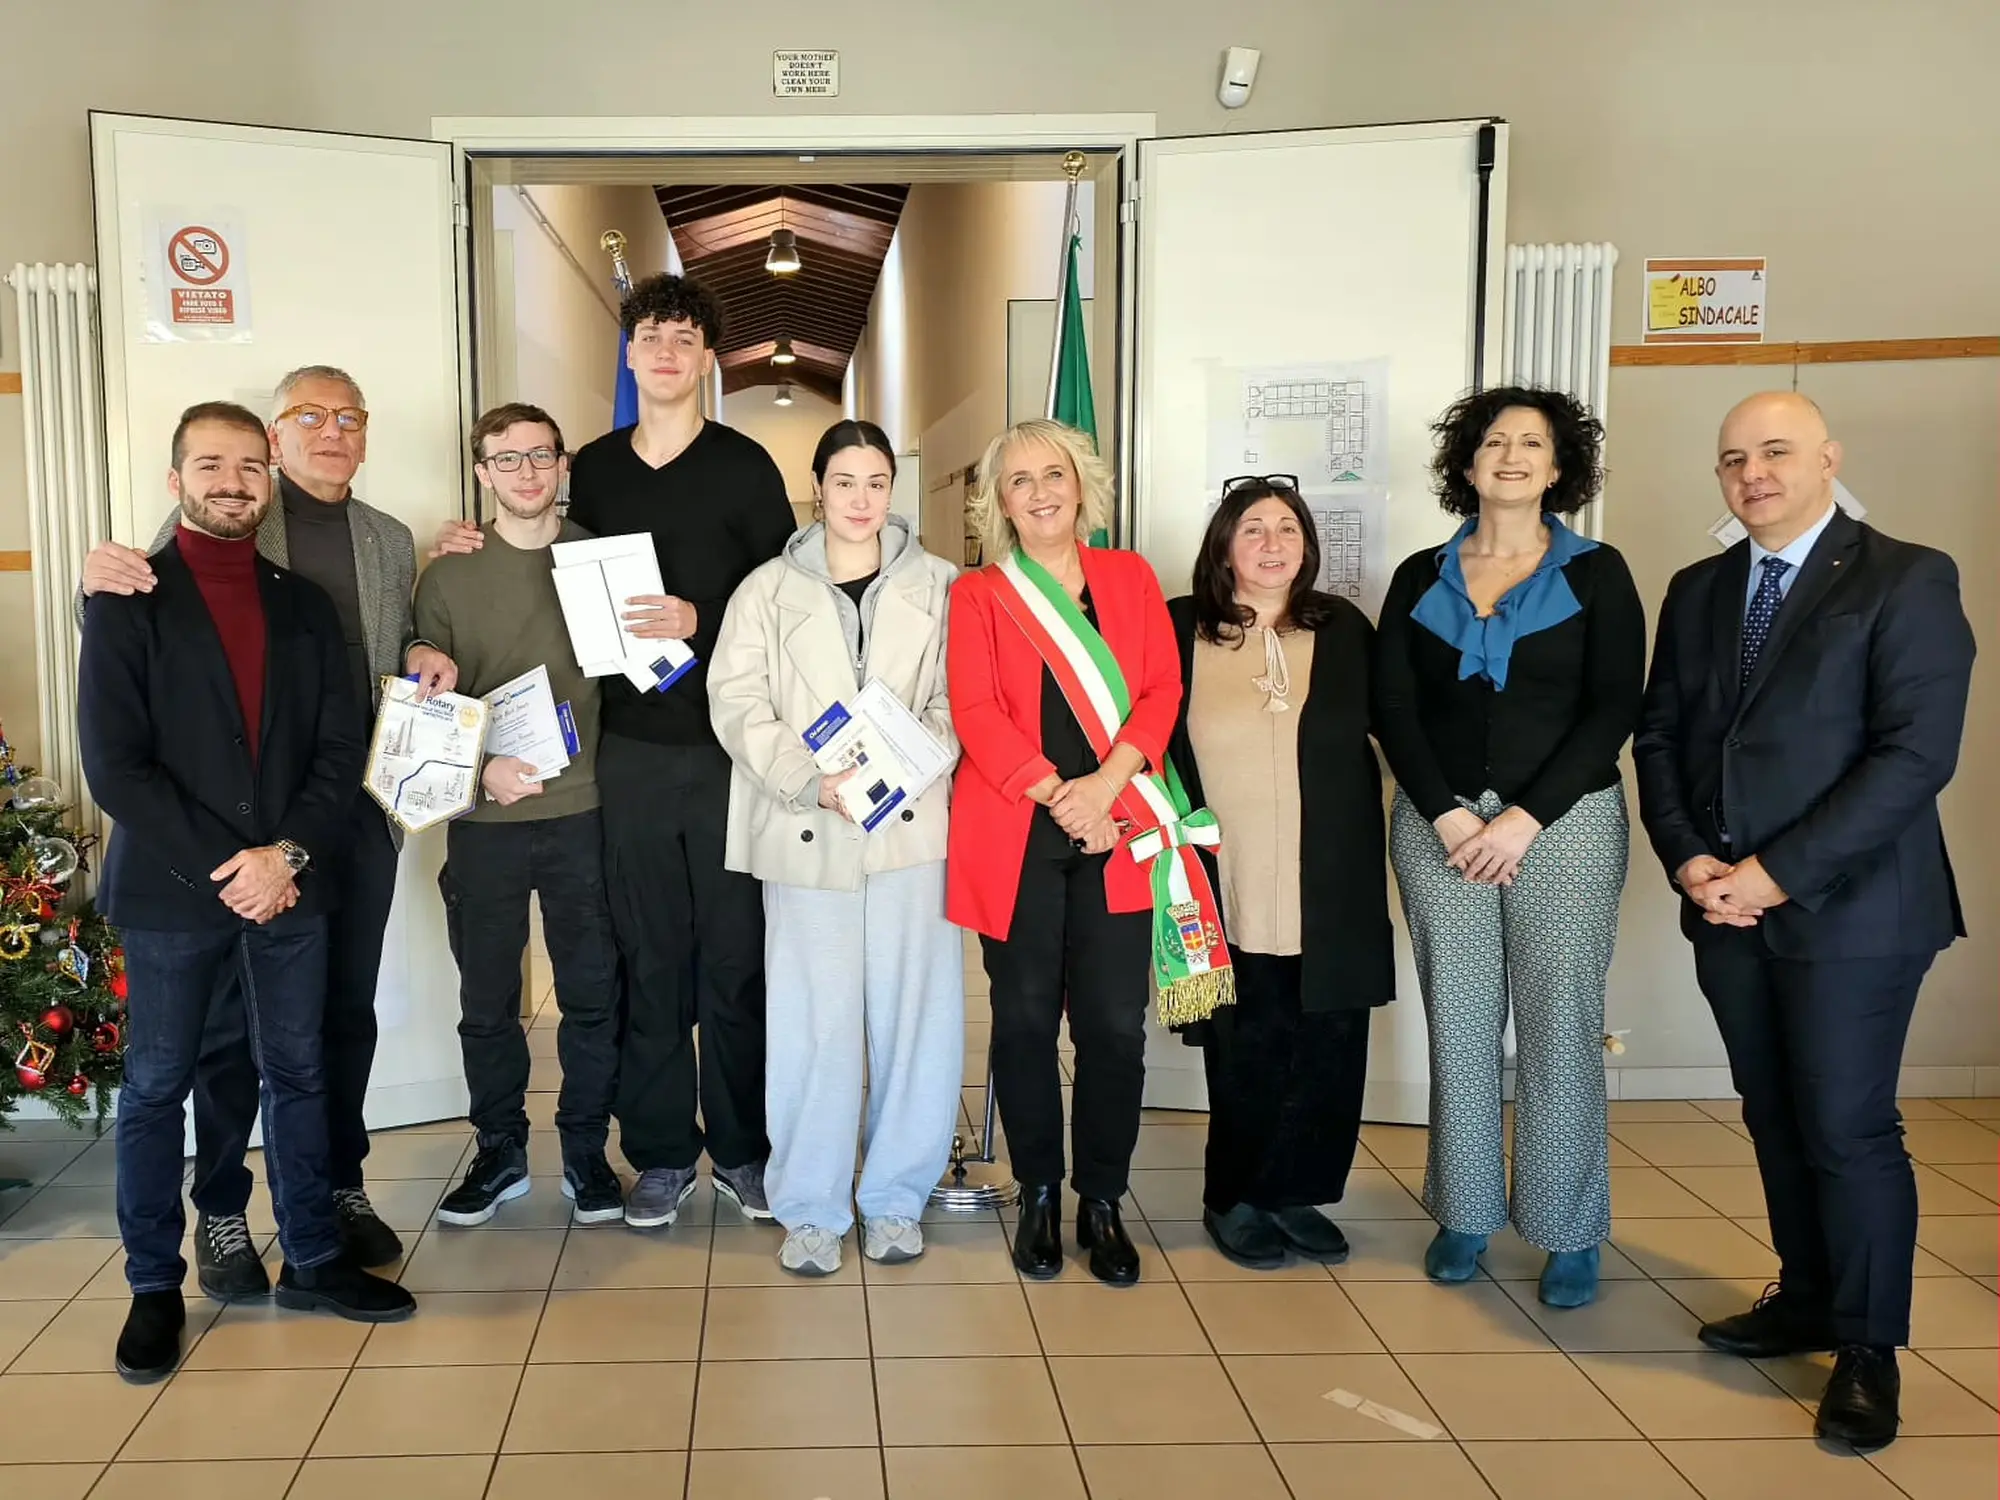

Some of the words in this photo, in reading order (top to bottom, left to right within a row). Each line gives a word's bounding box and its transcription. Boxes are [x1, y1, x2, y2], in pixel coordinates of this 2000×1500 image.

[776, 53, 799, 61] YOUR
[801, 53, 836, 61] MOTHER
[1680, 276, 1716, 297] ALBO
[178, 290, 227, 300] VIETATO
[1678, 305, 1759, 326] SINDACALE
[425, 696, 456, 712] Rotary
